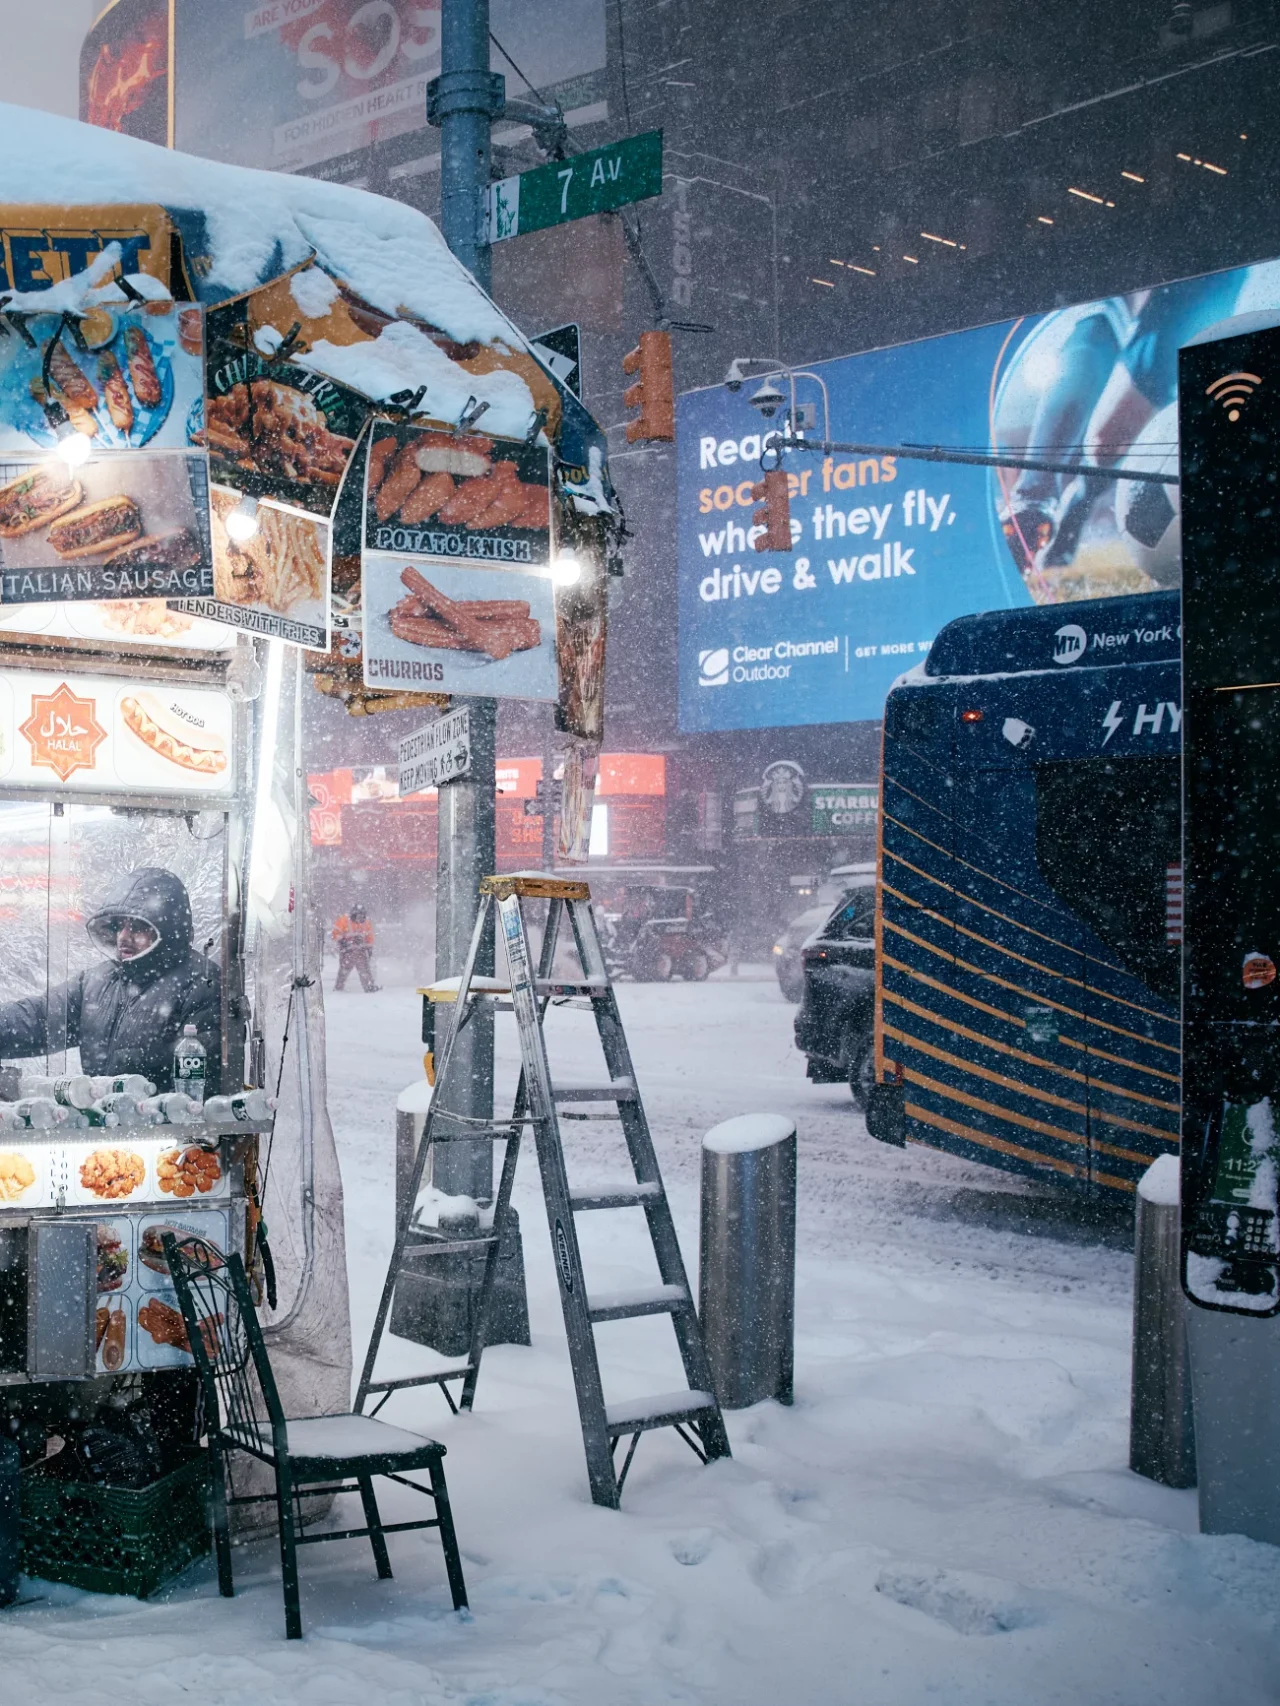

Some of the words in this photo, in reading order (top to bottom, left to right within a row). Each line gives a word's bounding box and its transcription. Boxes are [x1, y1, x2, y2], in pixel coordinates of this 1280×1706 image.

[252, 8, 279, 30] ARE
[284, 124, 308, 142] FOR
[367, 85, 413, 113] HEART
[557, 168, 573, 214] 7
[590, 156, 621, 188] AV
[299, 373, 350, 430] FRIES
[699, 469, 812, 514] socer
[822, 455, 897, 492] fans
[699, 521, 802, 557] whee
[812, 503, 893, 540] they
[902, 489, 956, 532] fly,
[376, 529, 461, 556] POTATO
[467, 536, 531, 562] KNISH
[0, 570, 92, 595] ITALIAN
[103, 568, 213, 593] SAUSAGE
[699, 564, 782, 602] drive
[793, 557, 817, 590] &
[827, 541, 916, 585] walk
[177, 600, 241, 625] TENDERS
[242, 608, 279, 636] WITH
[281, 619, 320, 646] FRIES
[733, 646, 773, 663] Clear
[775, 636, 838, 658] Channel
[855, 646, 877, 658] GET
[881, 643, 914, 655] MORE
[1054, 634, 1081, 657] MTA
[1093, 633, 1130, 649] New
[1134, 626, 1174, 643] York
[368, 658, 444, 681] CHURROS
[732, 664, 792, 683] Outdoor
[39, 710, 88, 738] حلال
[169, 702, 189, 717] HOT
[187, 713, 205, 728] DOG
[47, 739, 82, 752] HALAL
[400, 730, 434, 762] PEDESTRIAN
[436, 721, 452, 747] FLOW
[453, 712, 468, 740] ZONE
[400, 767, 414, 790] KEEP
[415, 757, 437, 788] MOVING
[815, 796, 878, 809] STARBU
[831, 813, 878, 825] COFF
[1227, 1158, 1257, 1173] 11:2
[558, 1233, 571, 1281] WERNER
